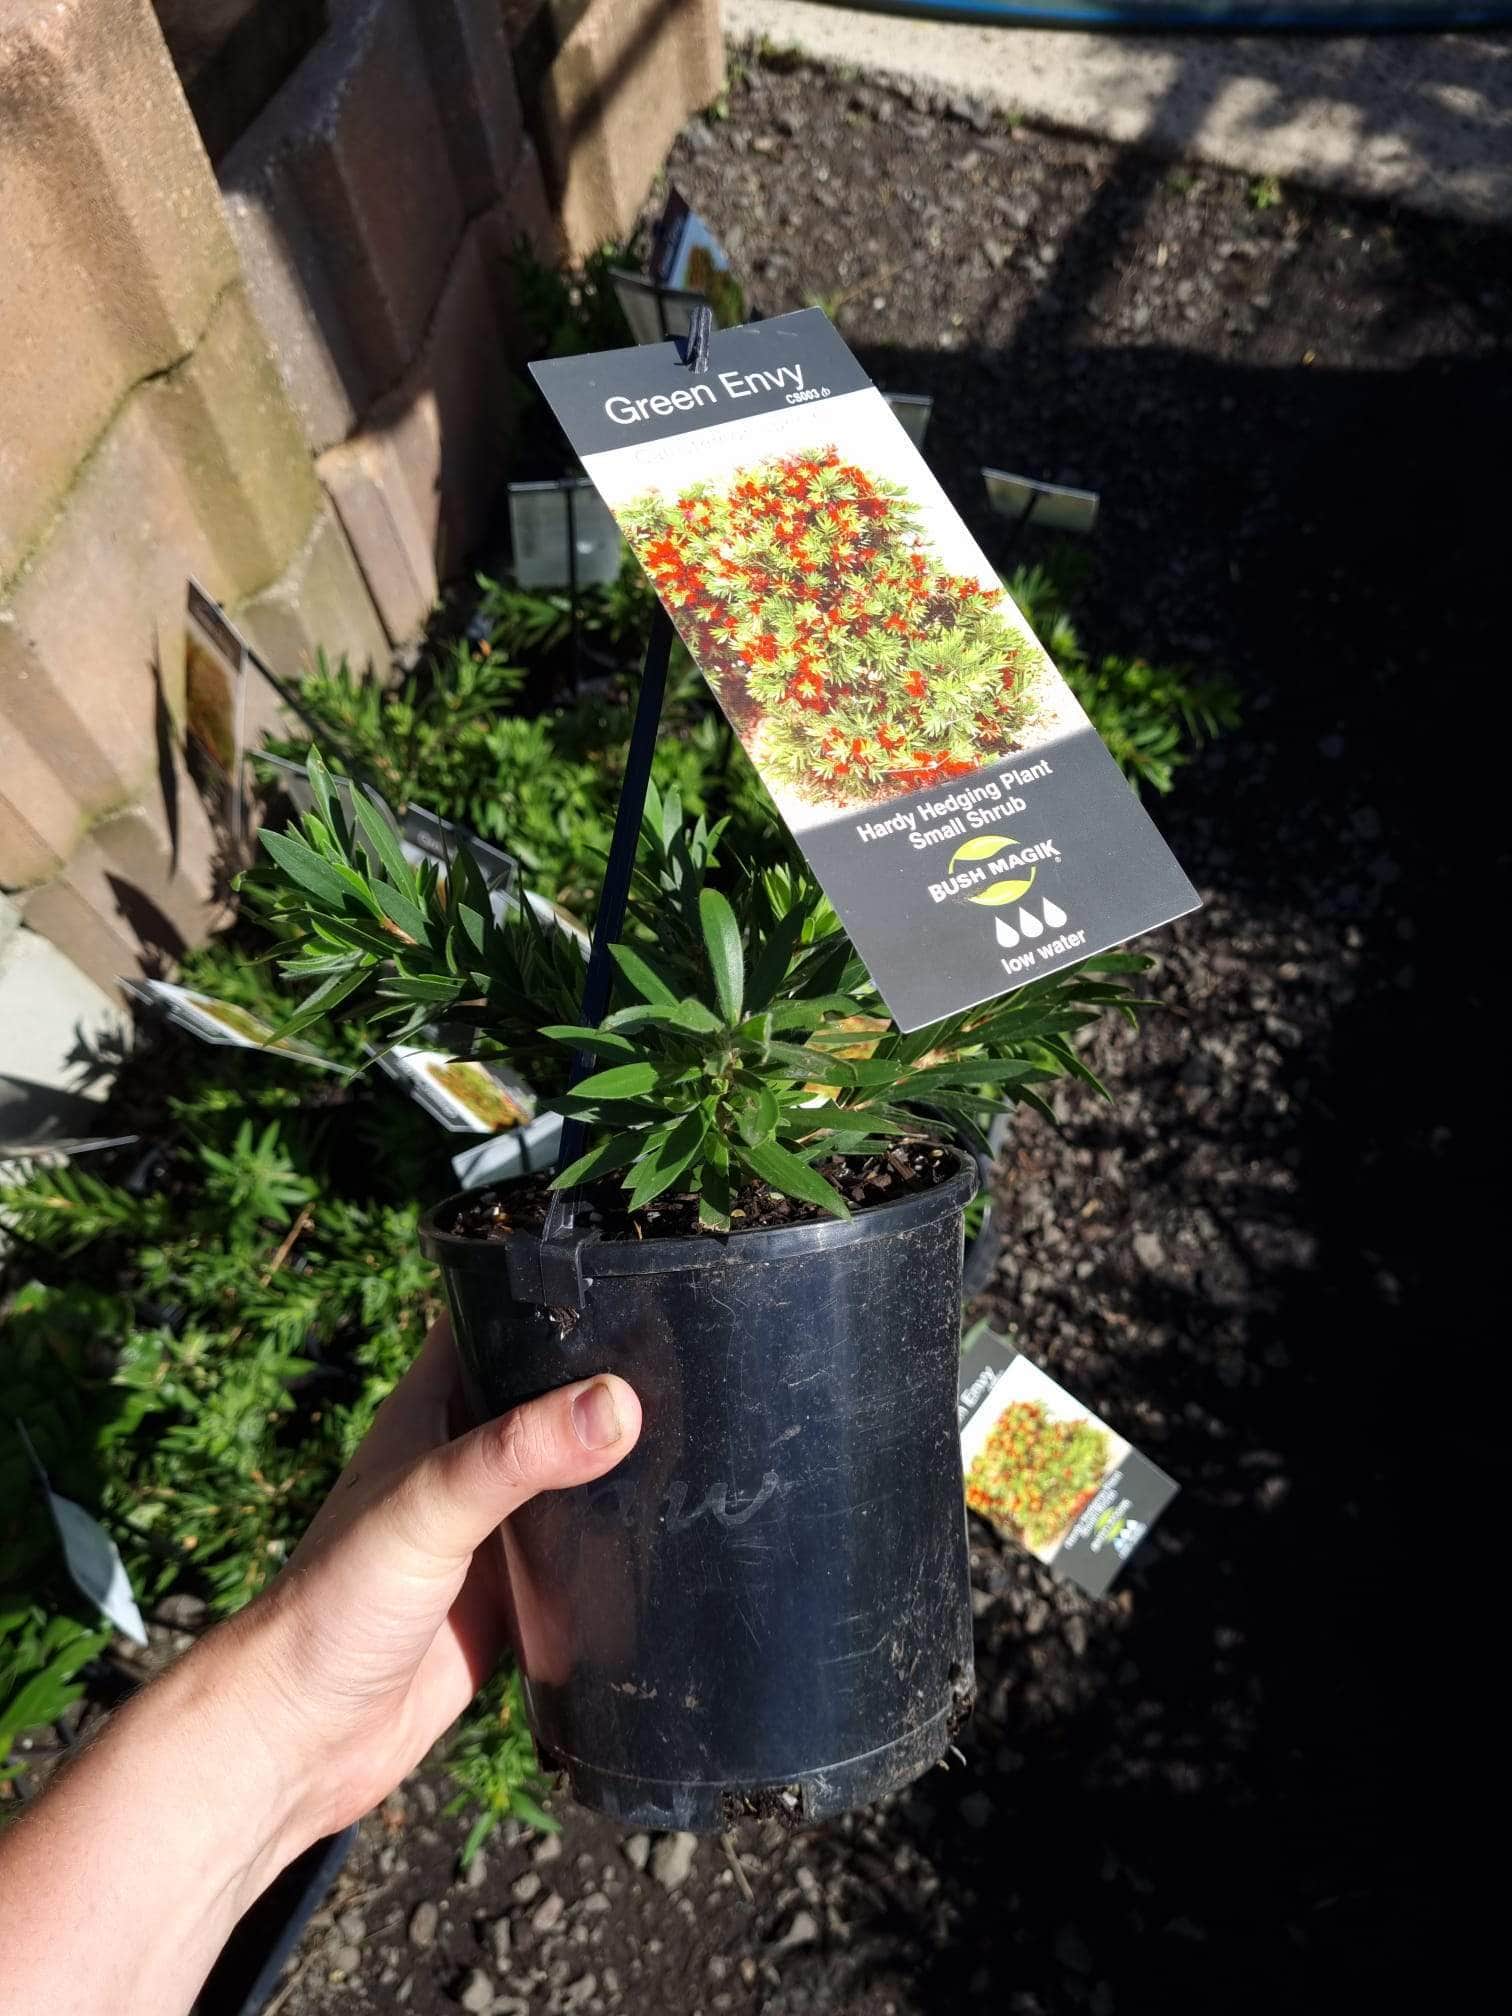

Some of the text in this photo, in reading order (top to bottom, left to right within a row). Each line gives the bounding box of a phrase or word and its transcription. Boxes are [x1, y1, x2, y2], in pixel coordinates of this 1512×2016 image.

[605, 363, 804, 425] Green Envy
[785, 389, 820, 404] CS003
[856, 759, 1054, 843] Hardy Hedging Plant
[908, 797, 1027, 850] Small Shrub
[927, 839, 1061, 903] BUSH MAGIK
[1001, 928, 1086, 975] low water
